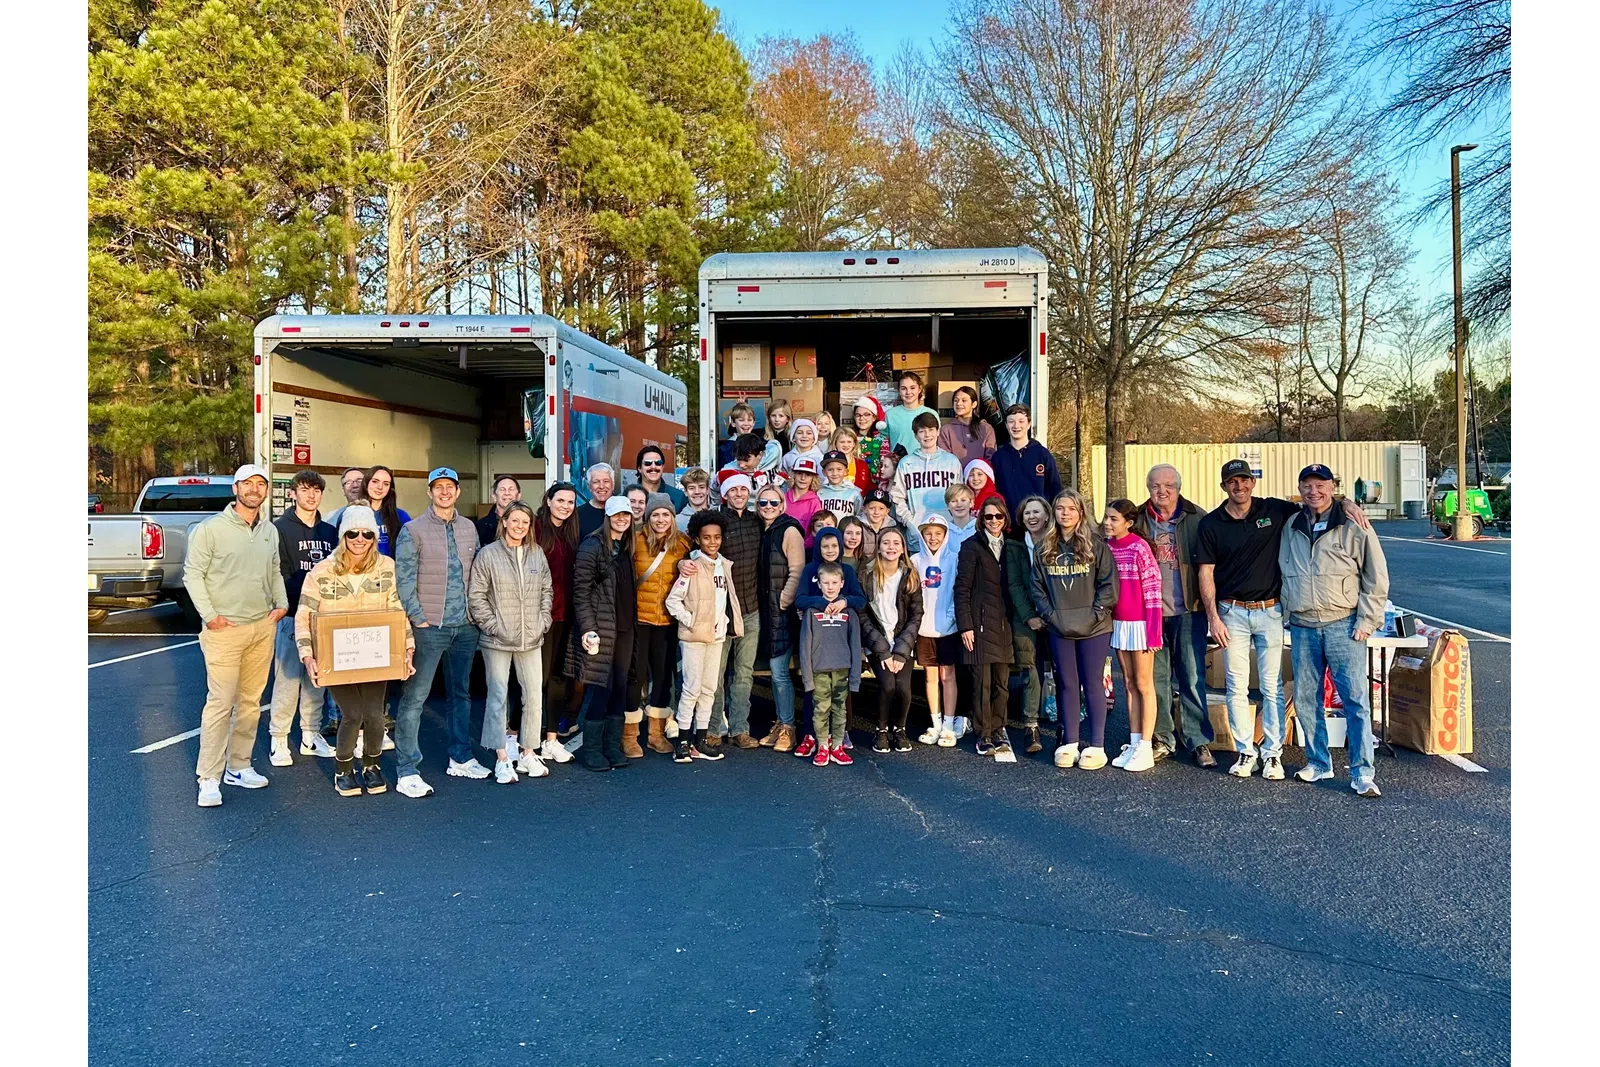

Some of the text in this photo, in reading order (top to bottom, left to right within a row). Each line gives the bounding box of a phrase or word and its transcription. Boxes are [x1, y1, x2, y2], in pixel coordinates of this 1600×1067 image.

[979, 258, 1016, 266] JH 2810 D
[644, 384, 675, 416] U-HAUL
[1070, 563, 1090, 575] LIONS
[1438, 640, 1460, 752] COSTCO
[1460, 645, 1469, 719] WHOLESALE
